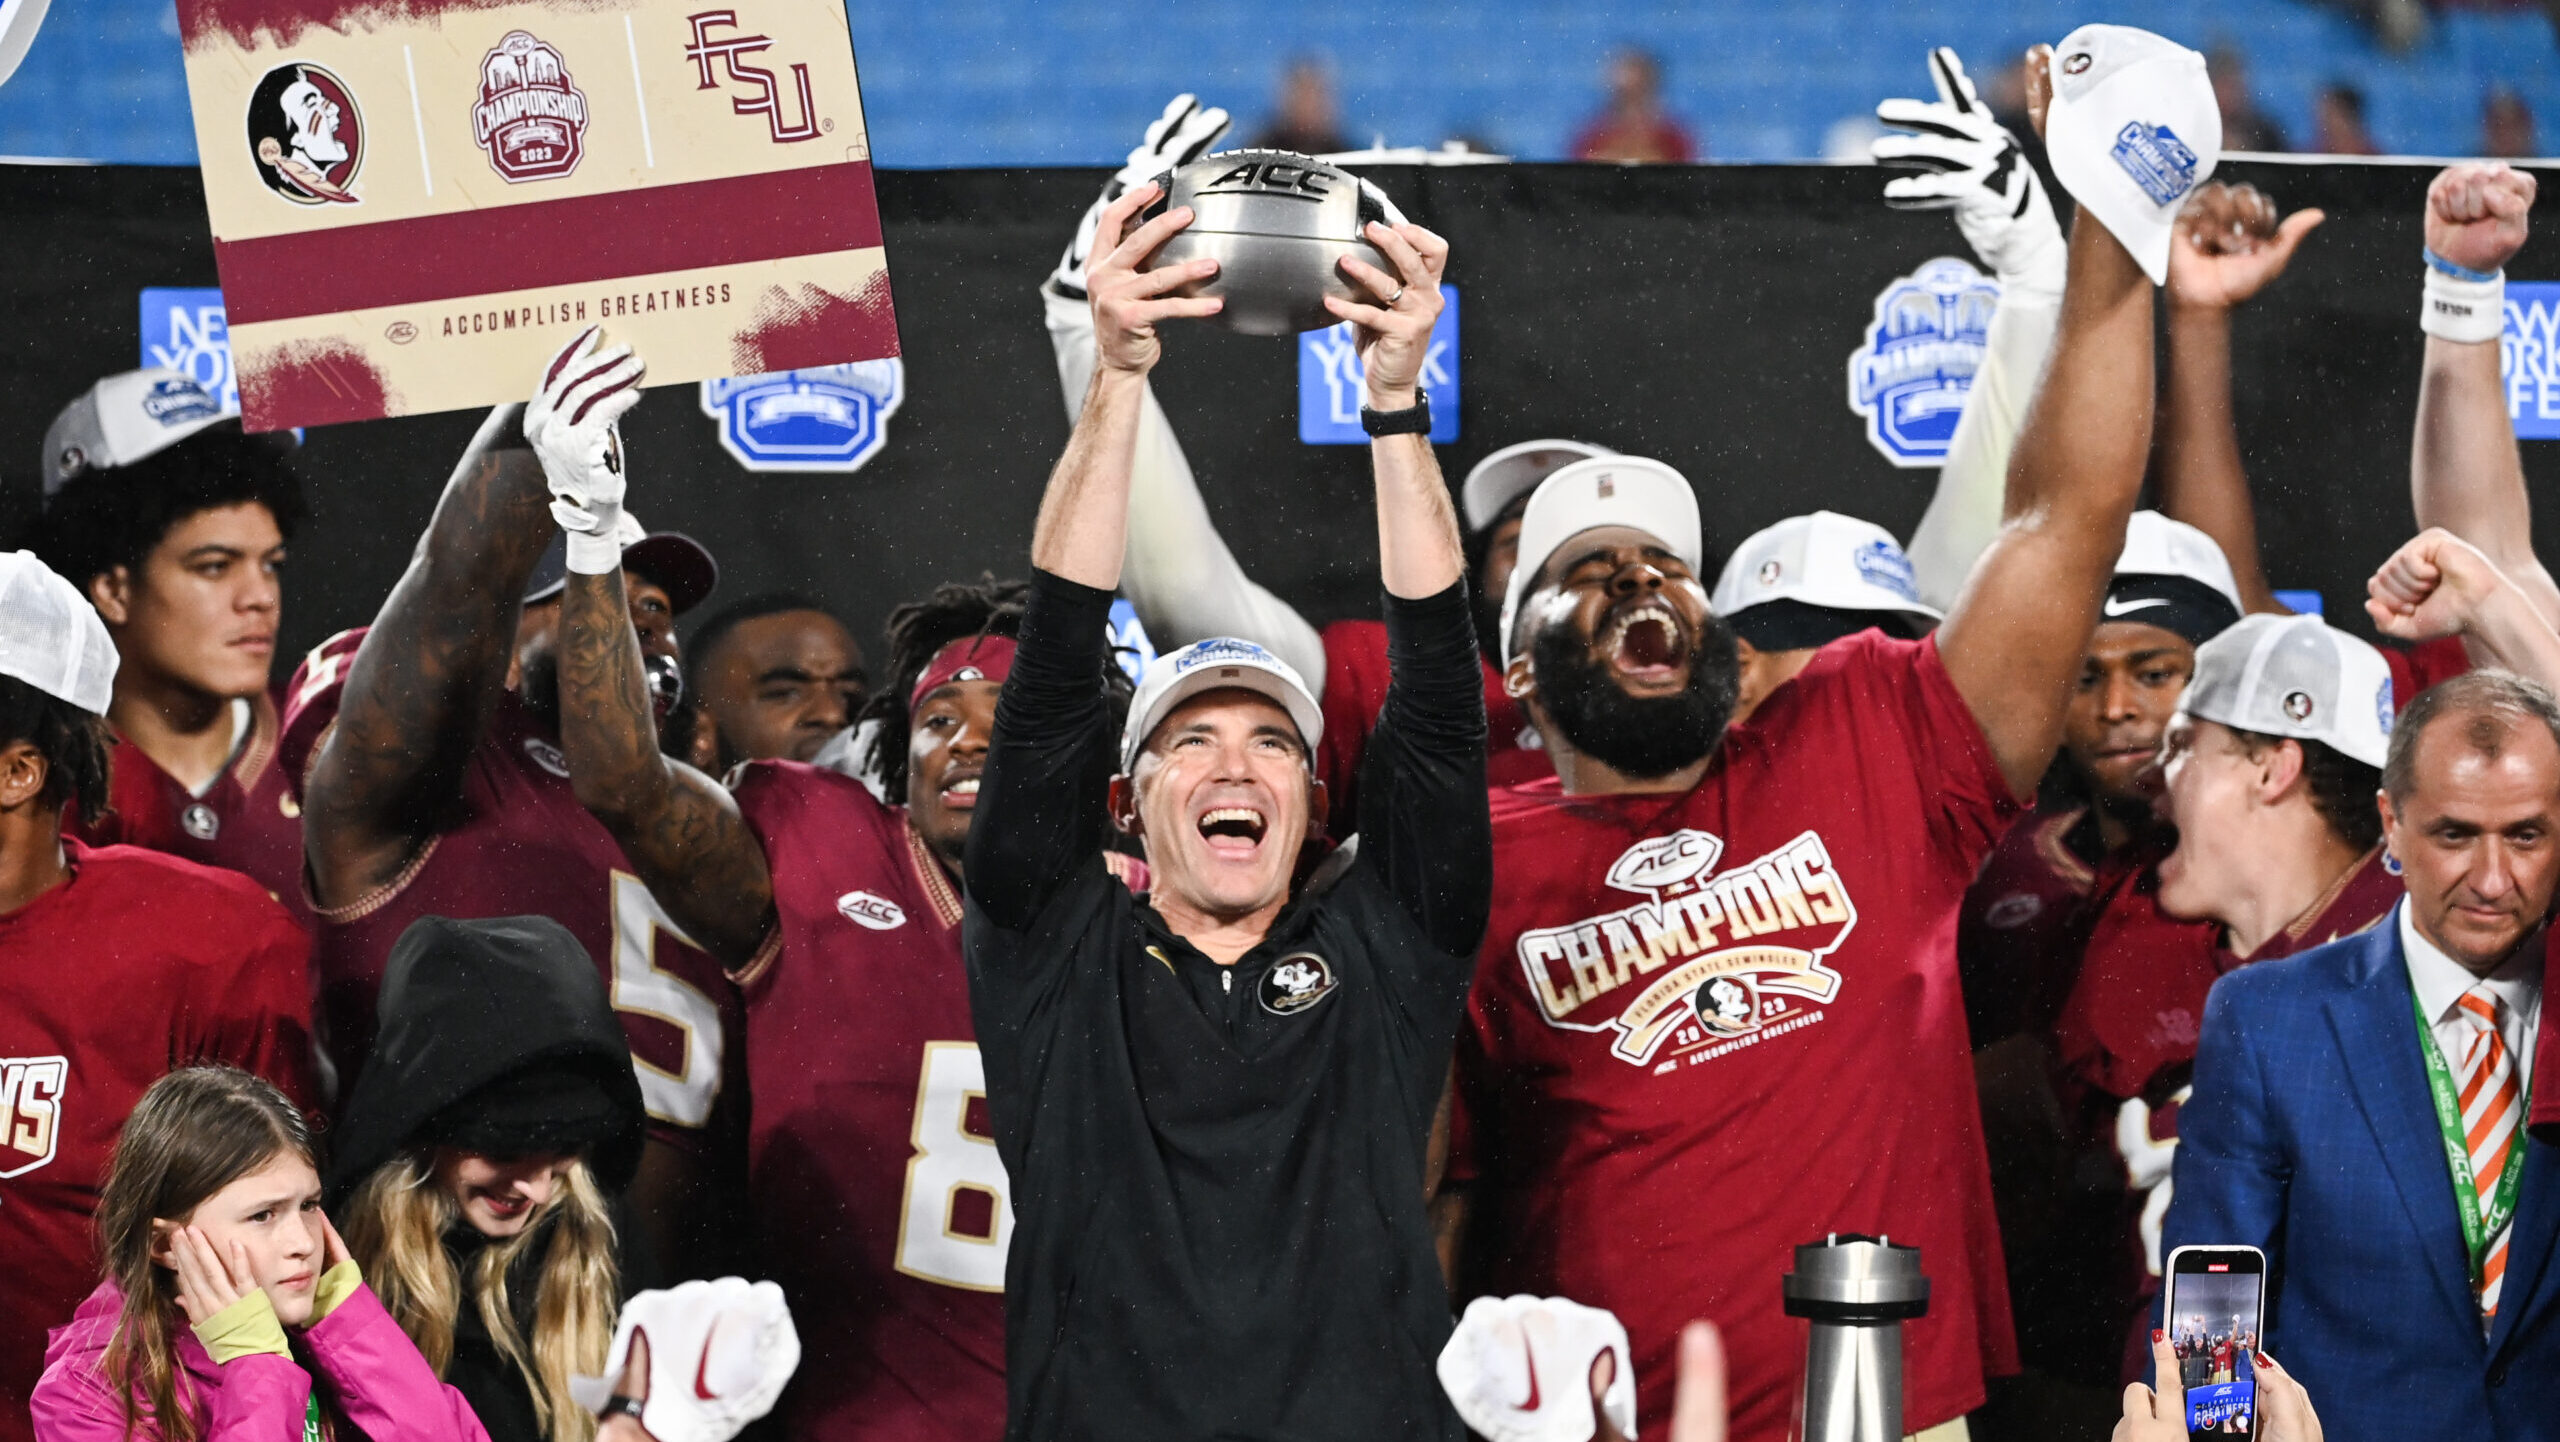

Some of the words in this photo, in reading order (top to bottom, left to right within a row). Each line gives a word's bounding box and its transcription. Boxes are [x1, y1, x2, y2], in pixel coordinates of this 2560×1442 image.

[684, 10, 823, 143] FSU
[476, 88, 583, 141] CHAMPIONSHIP
[519, 146, 553, 163] 2023
[1207, 163, 1339, 194] ACC
[169, 305, 230, 350] NE
[443, 301, 586, 337] ACCOMPLISH
[601, 283, 732, 318] GREATNESS
[1632, 839, 1698, 875] ACC
[849, 897, 899, 924] ACC
[1521, 836, 1849, 1019] CHAMPIONS
[610, 868, 724, 1128] 5
[1635, 979, 1681, 1018] FLORIDA
[1685, 961, 1721, 981] STATE
[1727, 953, 1798, 967] SEMINOLES
[1676, 1025, 1701, 1046] 20
[1762, 996, 1787, 1017] 23
[1689, 1033, 1760, 1066] ACCOMPLISH
[1762, 1010, 1824, 1040] GREATNESS
[895, 1040, 1016, 1293] 8
[2448, 1138, 2475, 1187] ACC
[2213, 1386, 2233, 1398] ACC
